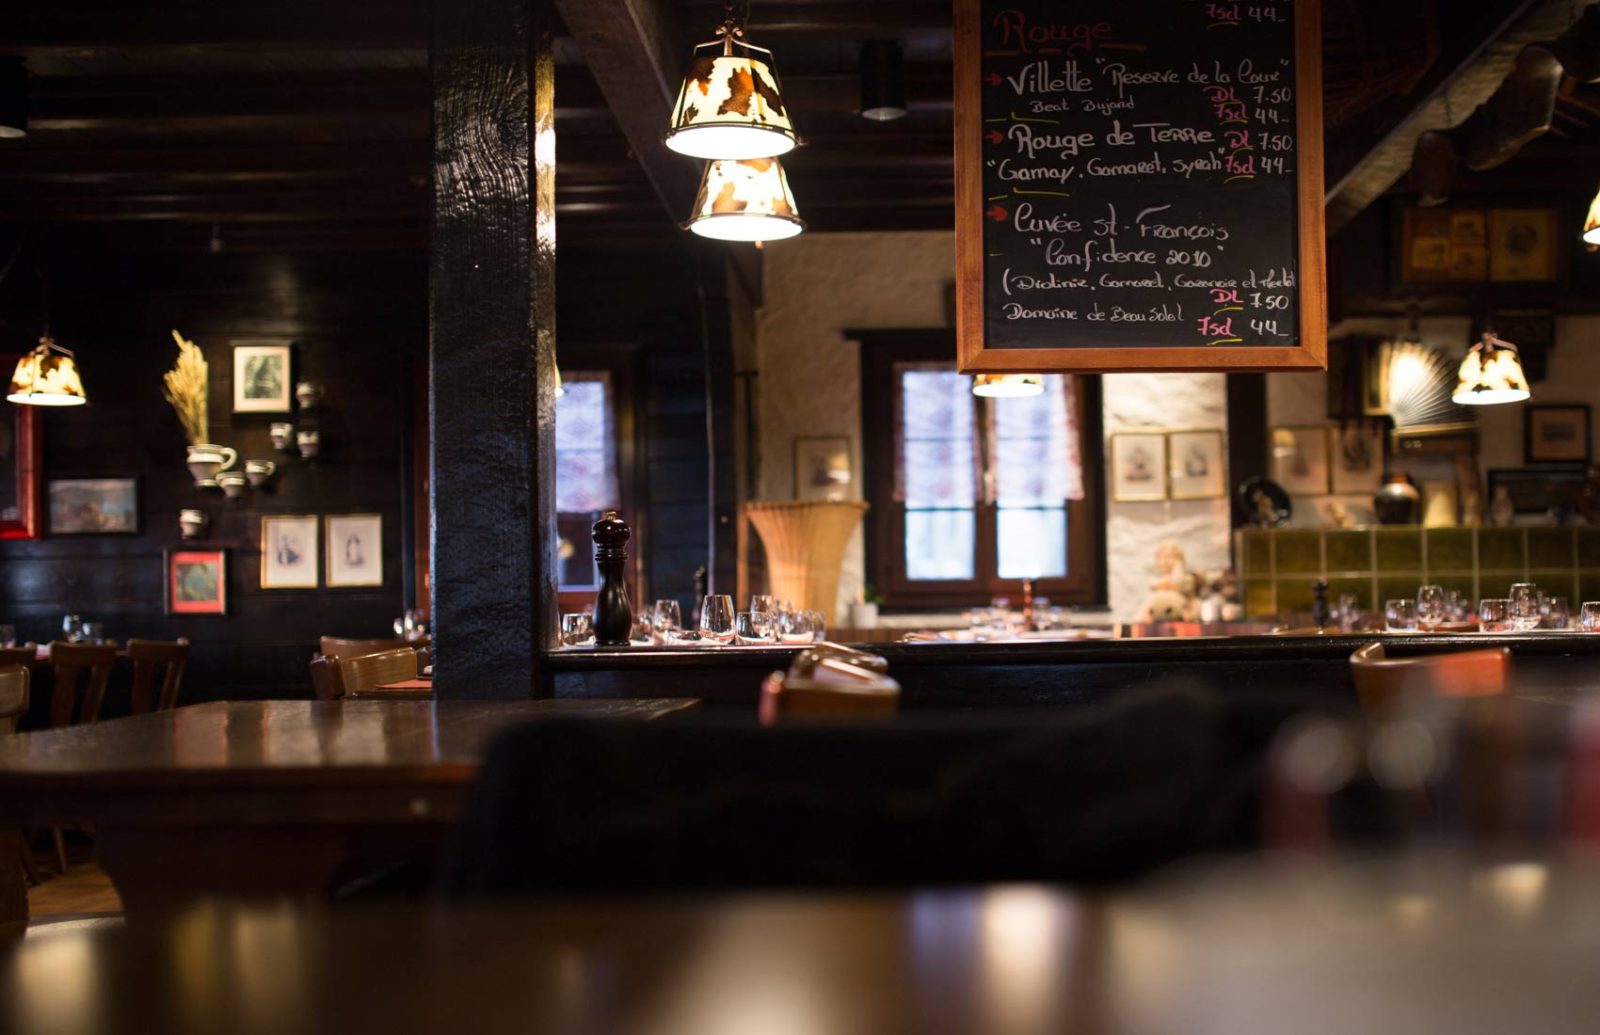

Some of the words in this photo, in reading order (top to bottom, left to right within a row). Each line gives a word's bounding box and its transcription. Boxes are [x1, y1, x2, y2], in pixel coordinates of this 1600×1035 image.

[992, 9, 1113, 58] Rouge
[1006, 60, 1094, 96] Villette
[1187, 62, 1211, 84] de
[1214, 60, 1232, 84] la
[1029, 97, 1070, 113] Beat
[1252, 85, 1292, 104] 7.50
[1007, 123, 1096, 160] Rouge
[1106, 120, 1136, 146] de
[1001, 302, 1079, 321] Domaine
[1086, 302, 1106, 321] de
